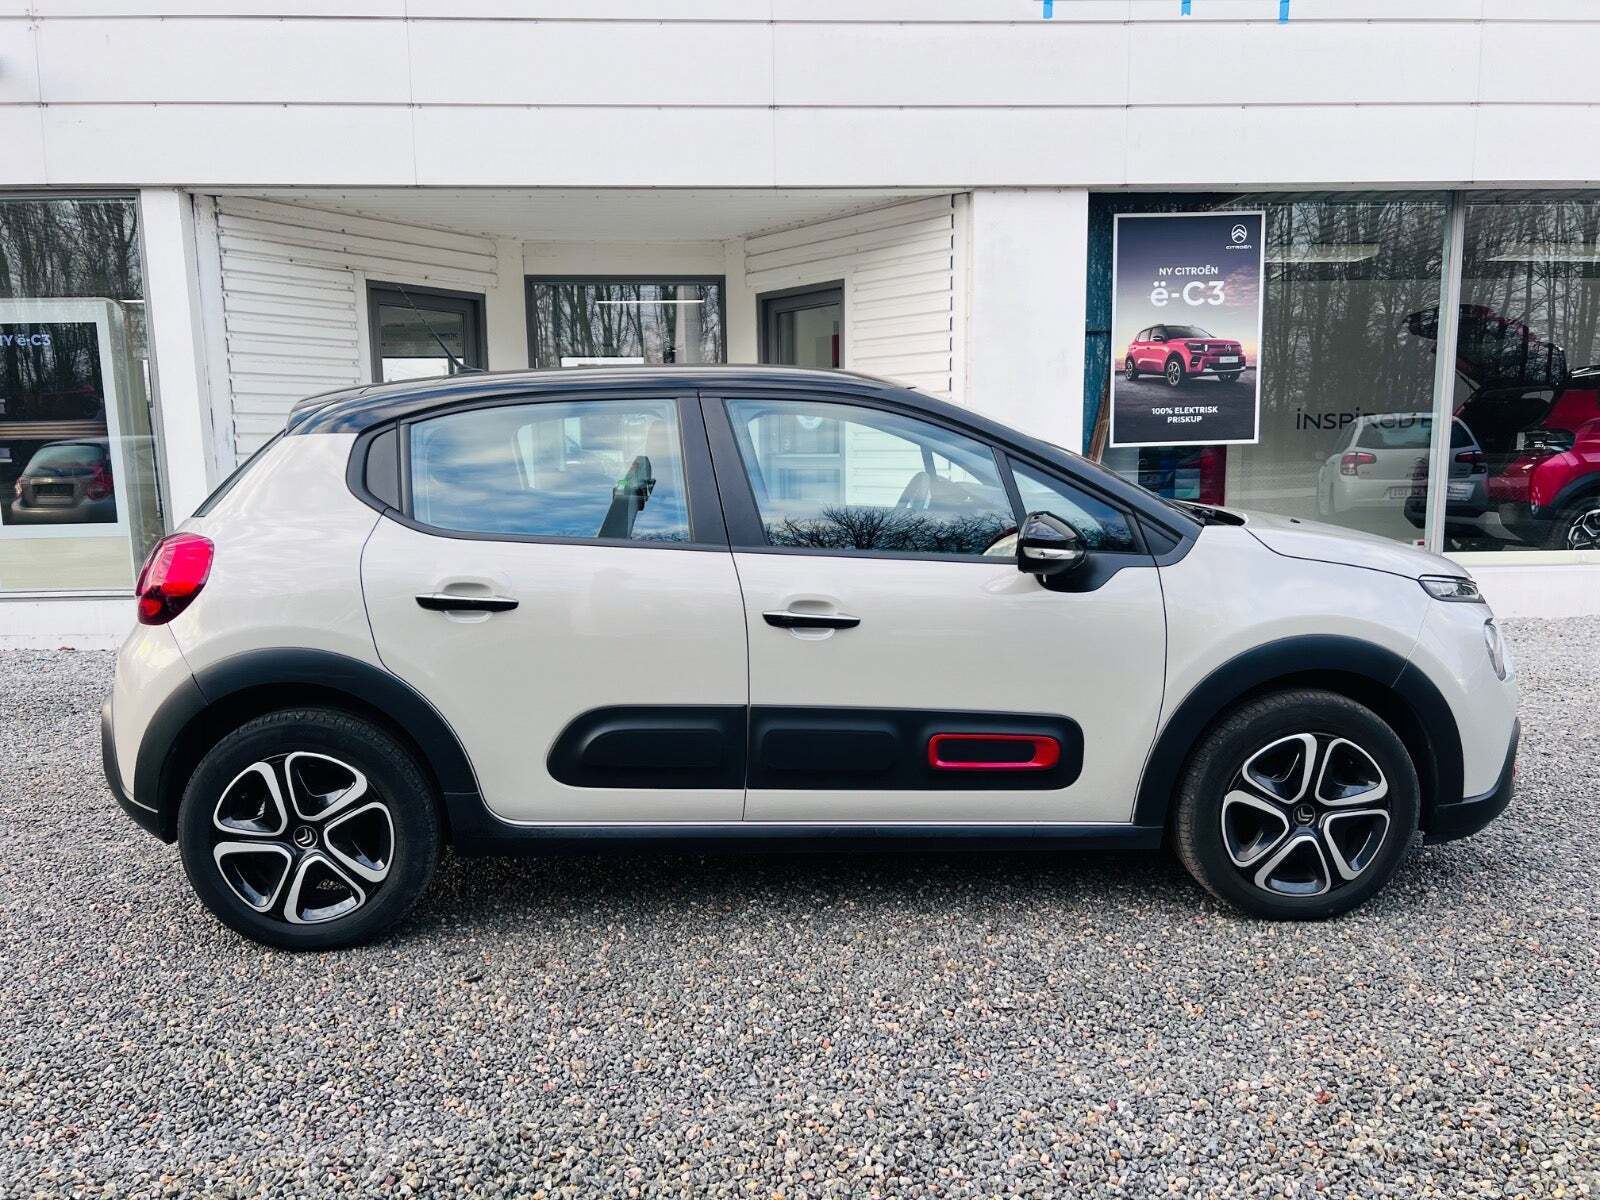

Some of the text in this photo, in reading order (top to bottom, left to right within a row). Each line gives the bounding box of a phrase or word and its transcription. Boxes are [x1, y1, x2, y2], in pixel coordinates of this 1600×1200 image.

[1159, 264, 1218, 276] NY CITROËN
[1150, 280, 1225, 307] ë-C3
[0, 334, 13, 346] Y
[1151, 406, 1218, 415] 100% ELEKTRISK
[1167, 415, 1202, 424] PRISKUP
